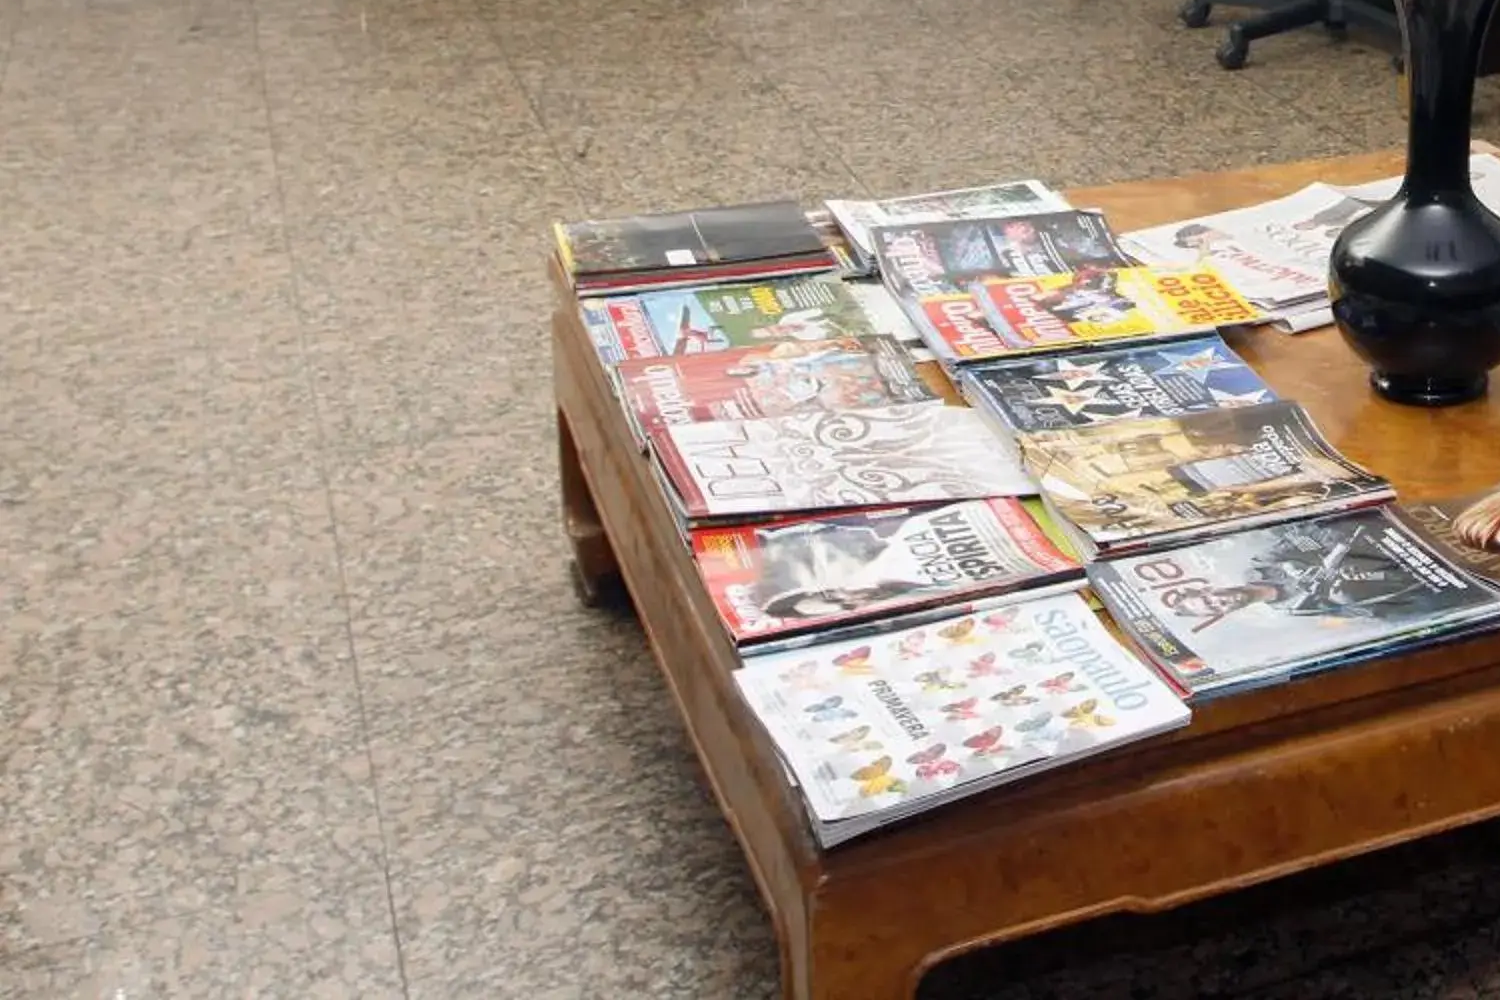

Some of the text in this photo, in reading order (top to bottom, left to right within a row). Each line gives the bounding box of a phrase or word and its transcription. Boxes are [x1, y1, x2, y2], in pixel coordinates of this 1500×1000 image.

[1177, 299, 1216, 324] ale
[1033, 608, 1152, 711] sãopaulo
[868, 679, 929, 741] PRIMAVERA
